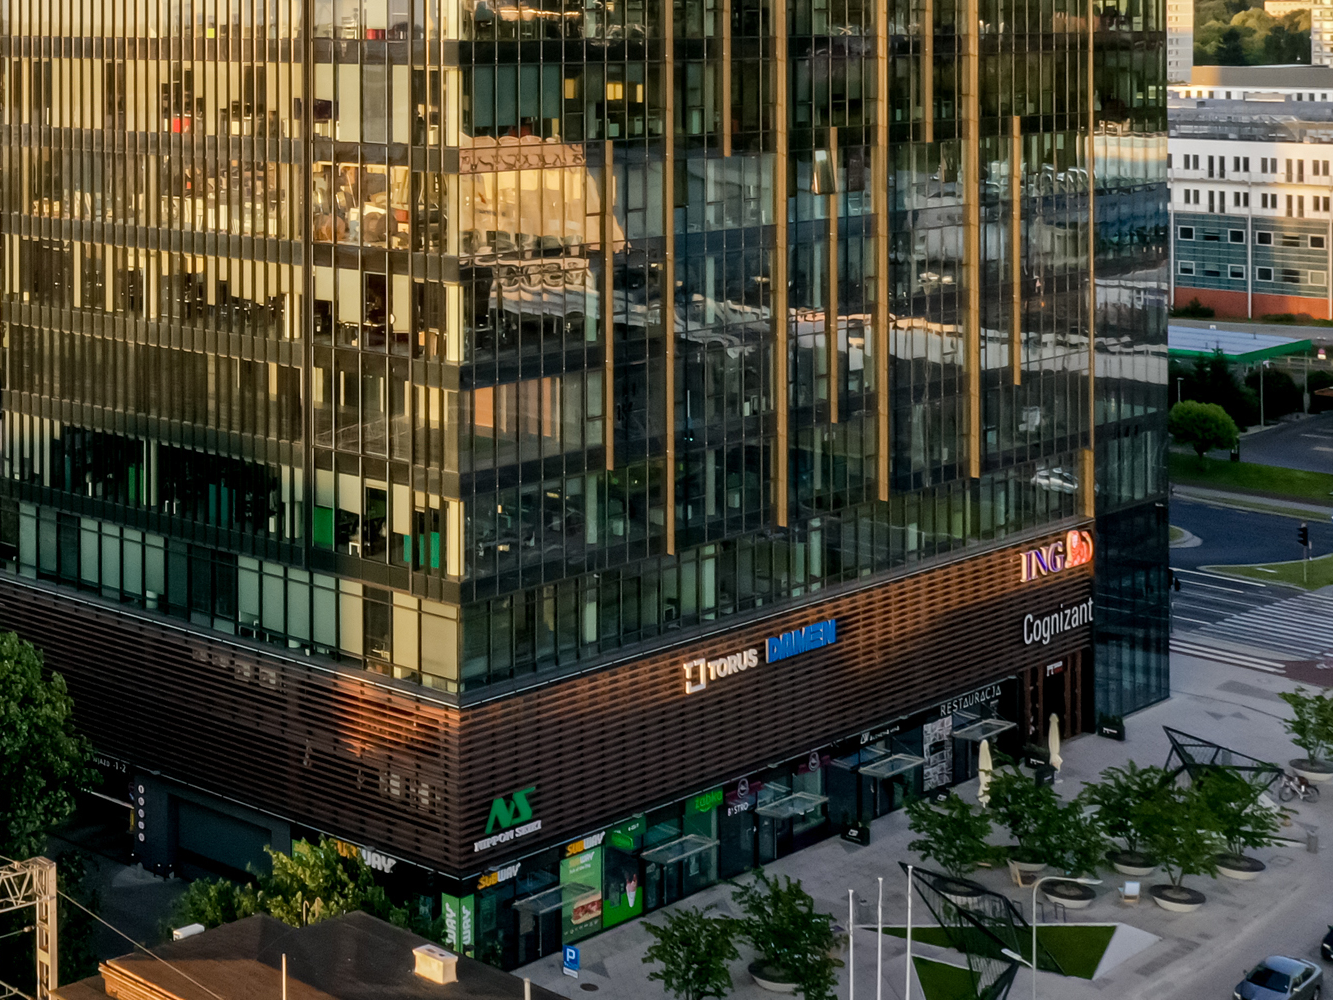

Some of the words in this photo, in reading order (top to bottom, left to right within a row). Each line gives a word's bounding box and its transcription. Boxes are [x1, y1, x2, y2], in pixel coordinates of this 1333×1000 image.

[1020, 541, 1065, 583] ING
[1023, 596, 1094, 645] Cognizant
[765, 618, 837, 664] DAMEN
[707, 648, 758, 681] TORUS
[940, 685, 1002, 716] RESTAURACJA
[485, 786, 536, 835] NS
[473, 829, 515, 853] NIPPON
[565, 831, 606, 857] SUBWAY
[477, 862, 521, 890] SUBWAY
[566, 947, 576, 962] P
